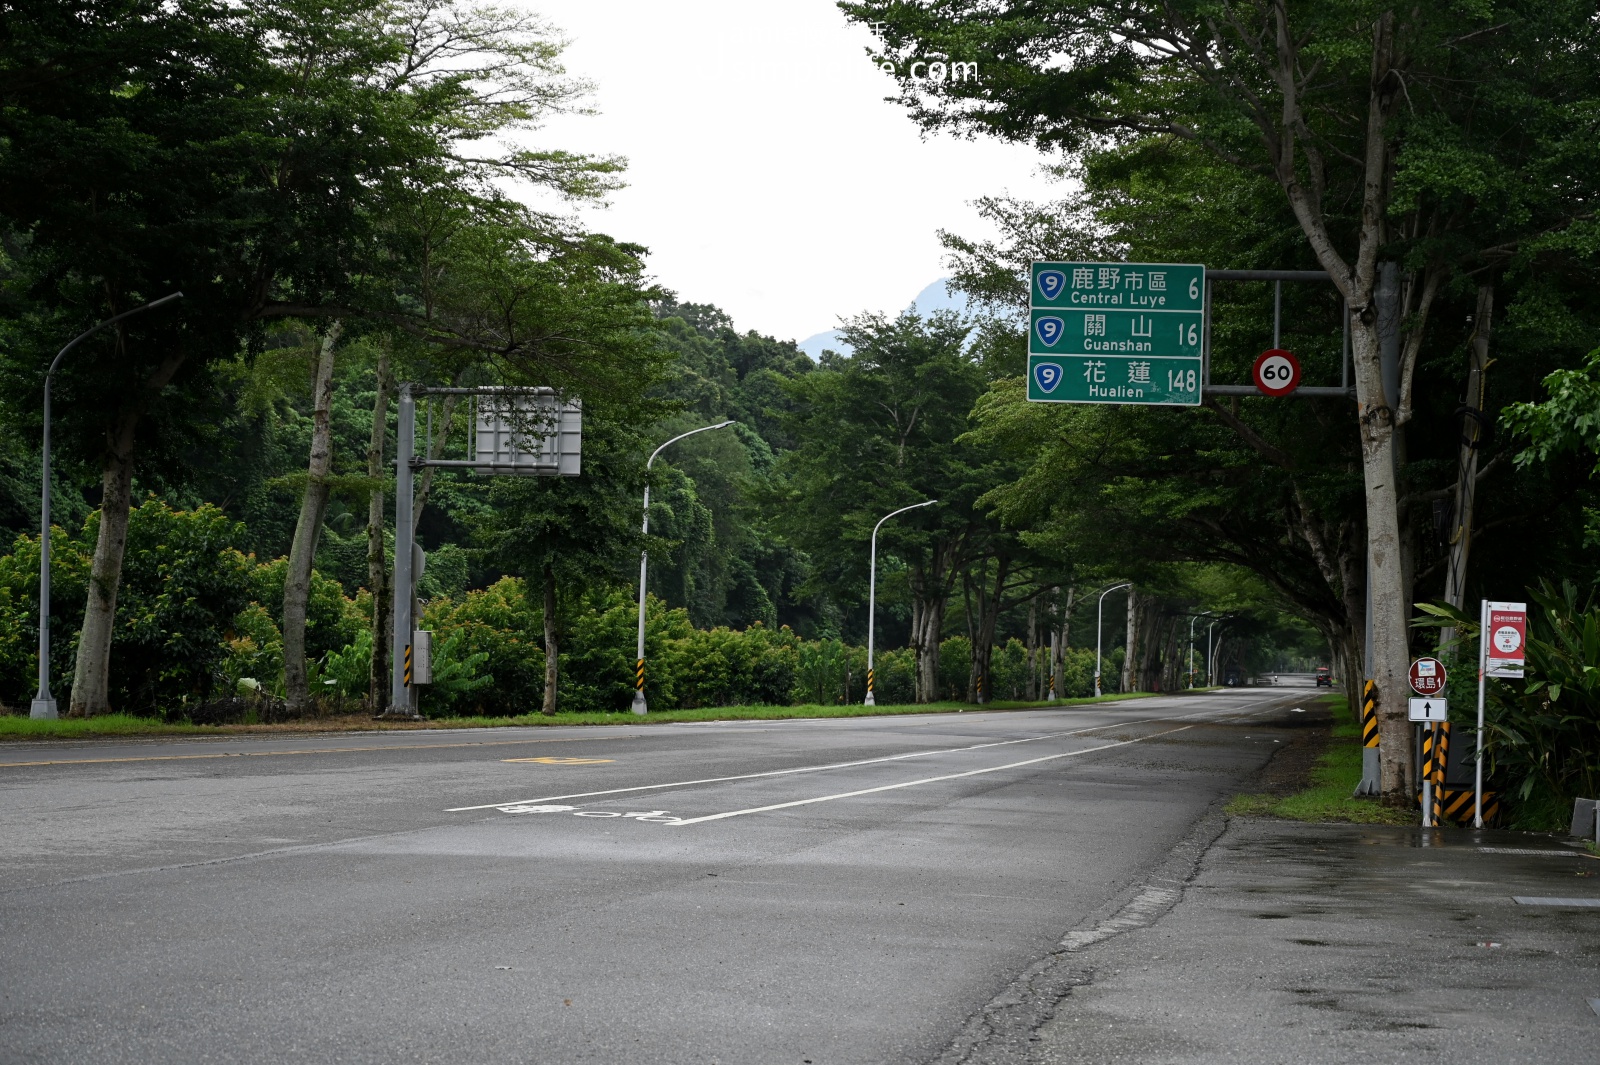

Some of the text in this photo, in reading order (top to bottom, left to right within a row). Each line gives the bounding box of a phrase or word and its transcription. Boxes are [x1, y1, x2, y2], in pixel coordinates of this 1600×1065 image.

[1045, 267, 1199, 300] 9 鹿野市區 6
[1071, 291, 1166, 308] Central Luye
[1044, 313, 1198, 346] 9 關山 16
[1083, 338, 1152, 352] Guanshan
[1042, 360, 1196, 393] 9 花蓮 148
[1263, 364, 1290, 381] 60
[1089, 385, 1144, 398] Hualien
